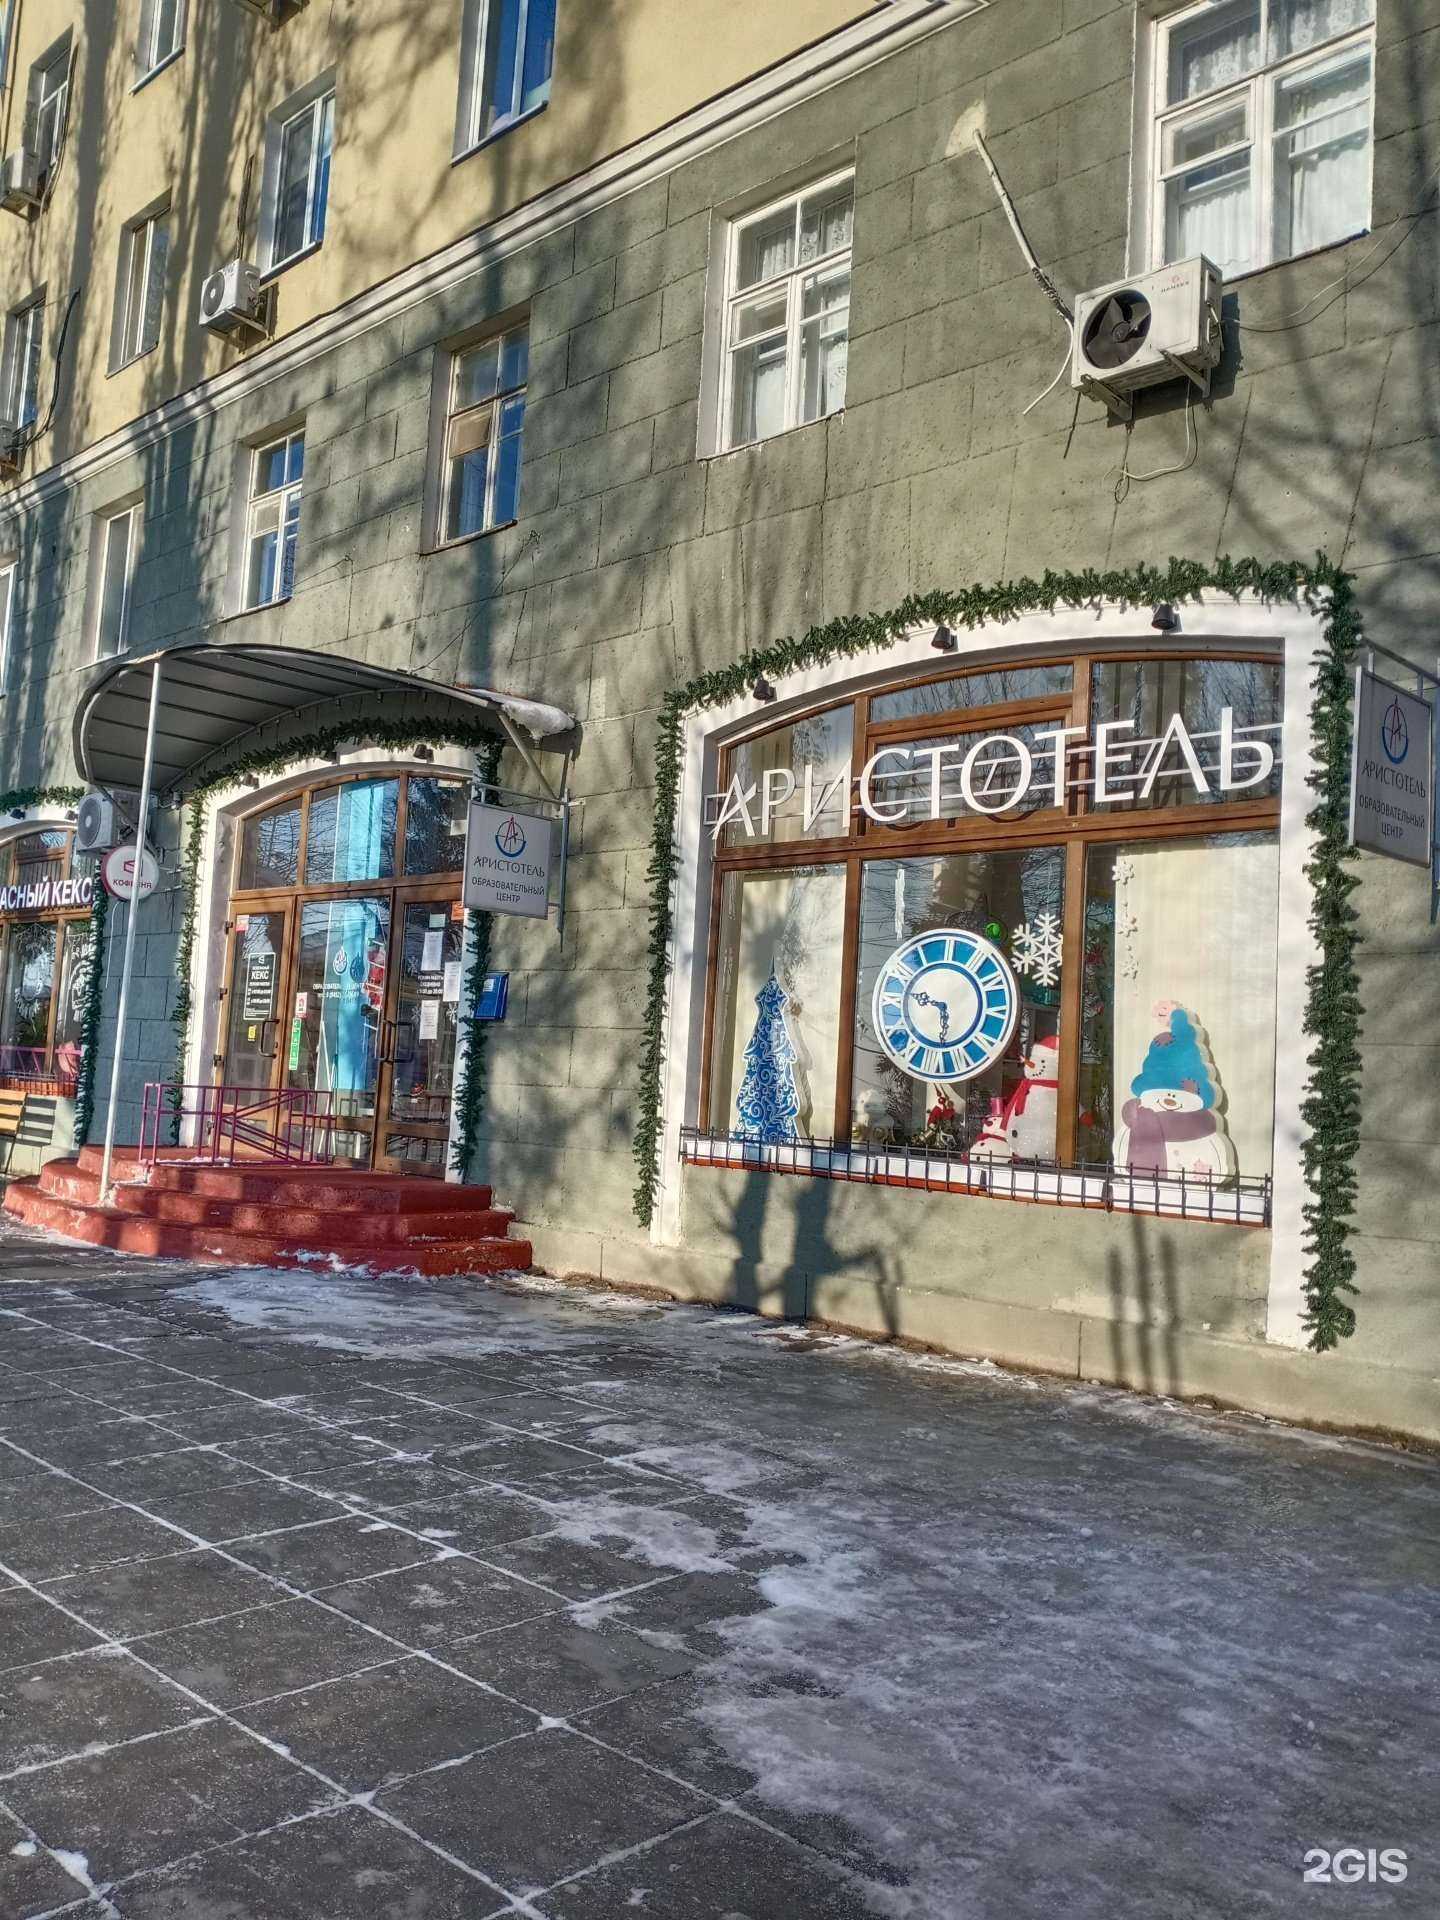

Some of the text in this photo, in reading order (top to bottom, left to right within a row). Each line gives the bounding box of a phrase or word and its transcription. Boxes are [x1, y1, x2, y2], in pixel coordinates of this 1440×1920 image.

[710, 706, 1275, 840] АРИСТОТЕЛЬ
[1361, 759, 1426, 799] АРИСТОТЕЛЬ
[1359, 794, 1425, 829] ОБРАЗОВАТЕЛЬНЫЙ
[1381, 821, 1404, 839] ЦЕНТР
[473, 855, 545, 878] АРИСТОТЕЛЬ
[0, 875, 92, 910] АСНЫЙ КЕКС
[471, 876, 545, 896] ОБРАЗОВАТЕЛЬНЫЙ
[496, 892, 520, 903] ЦЕНТР
